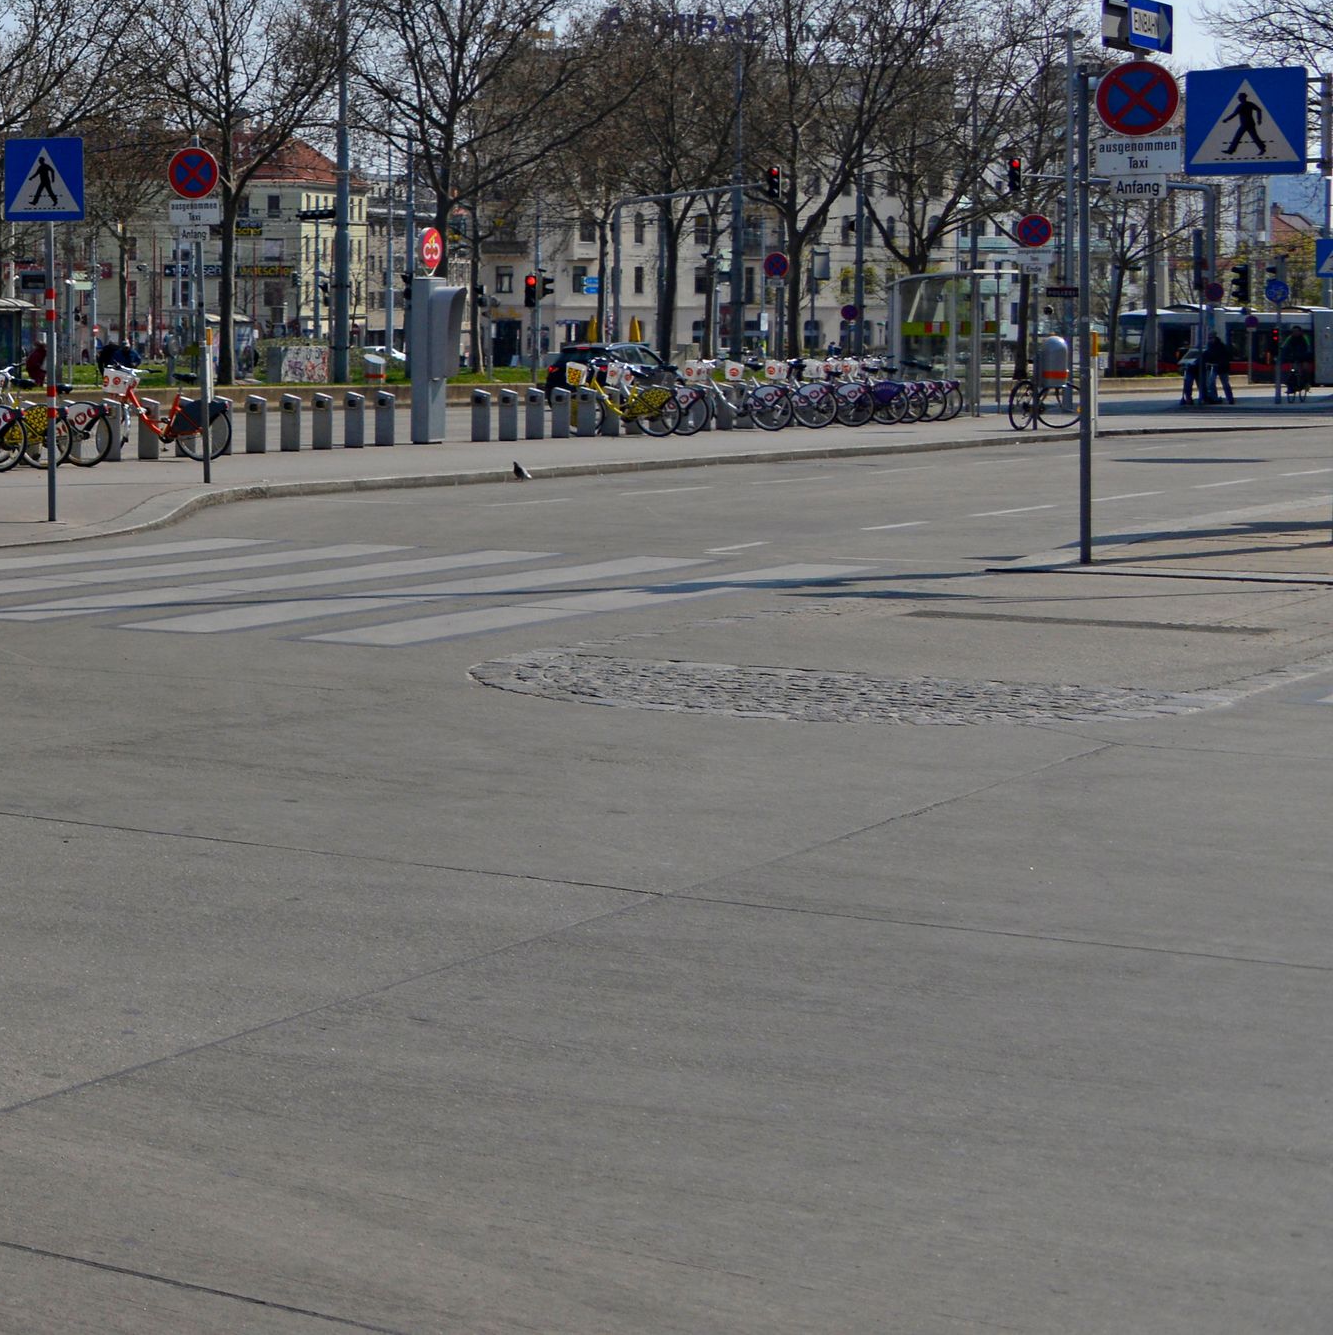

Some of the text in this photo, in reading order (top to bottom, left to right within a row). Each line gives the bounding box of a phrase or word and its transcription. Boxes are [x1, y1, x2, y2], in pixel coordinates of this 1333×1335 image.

[597, 7, 768, 42] AMIRAL
[1099, 140, 1177, 156] ausgenommen
[1128, 156, 1148, 168] Taxi
[1116, 180, 1160, 196] Anfang
[171, 202, 218, 211] ausgenommen
[188, 212, 201, 220] Taxi
[181, 229, 207, 241] Anfang
